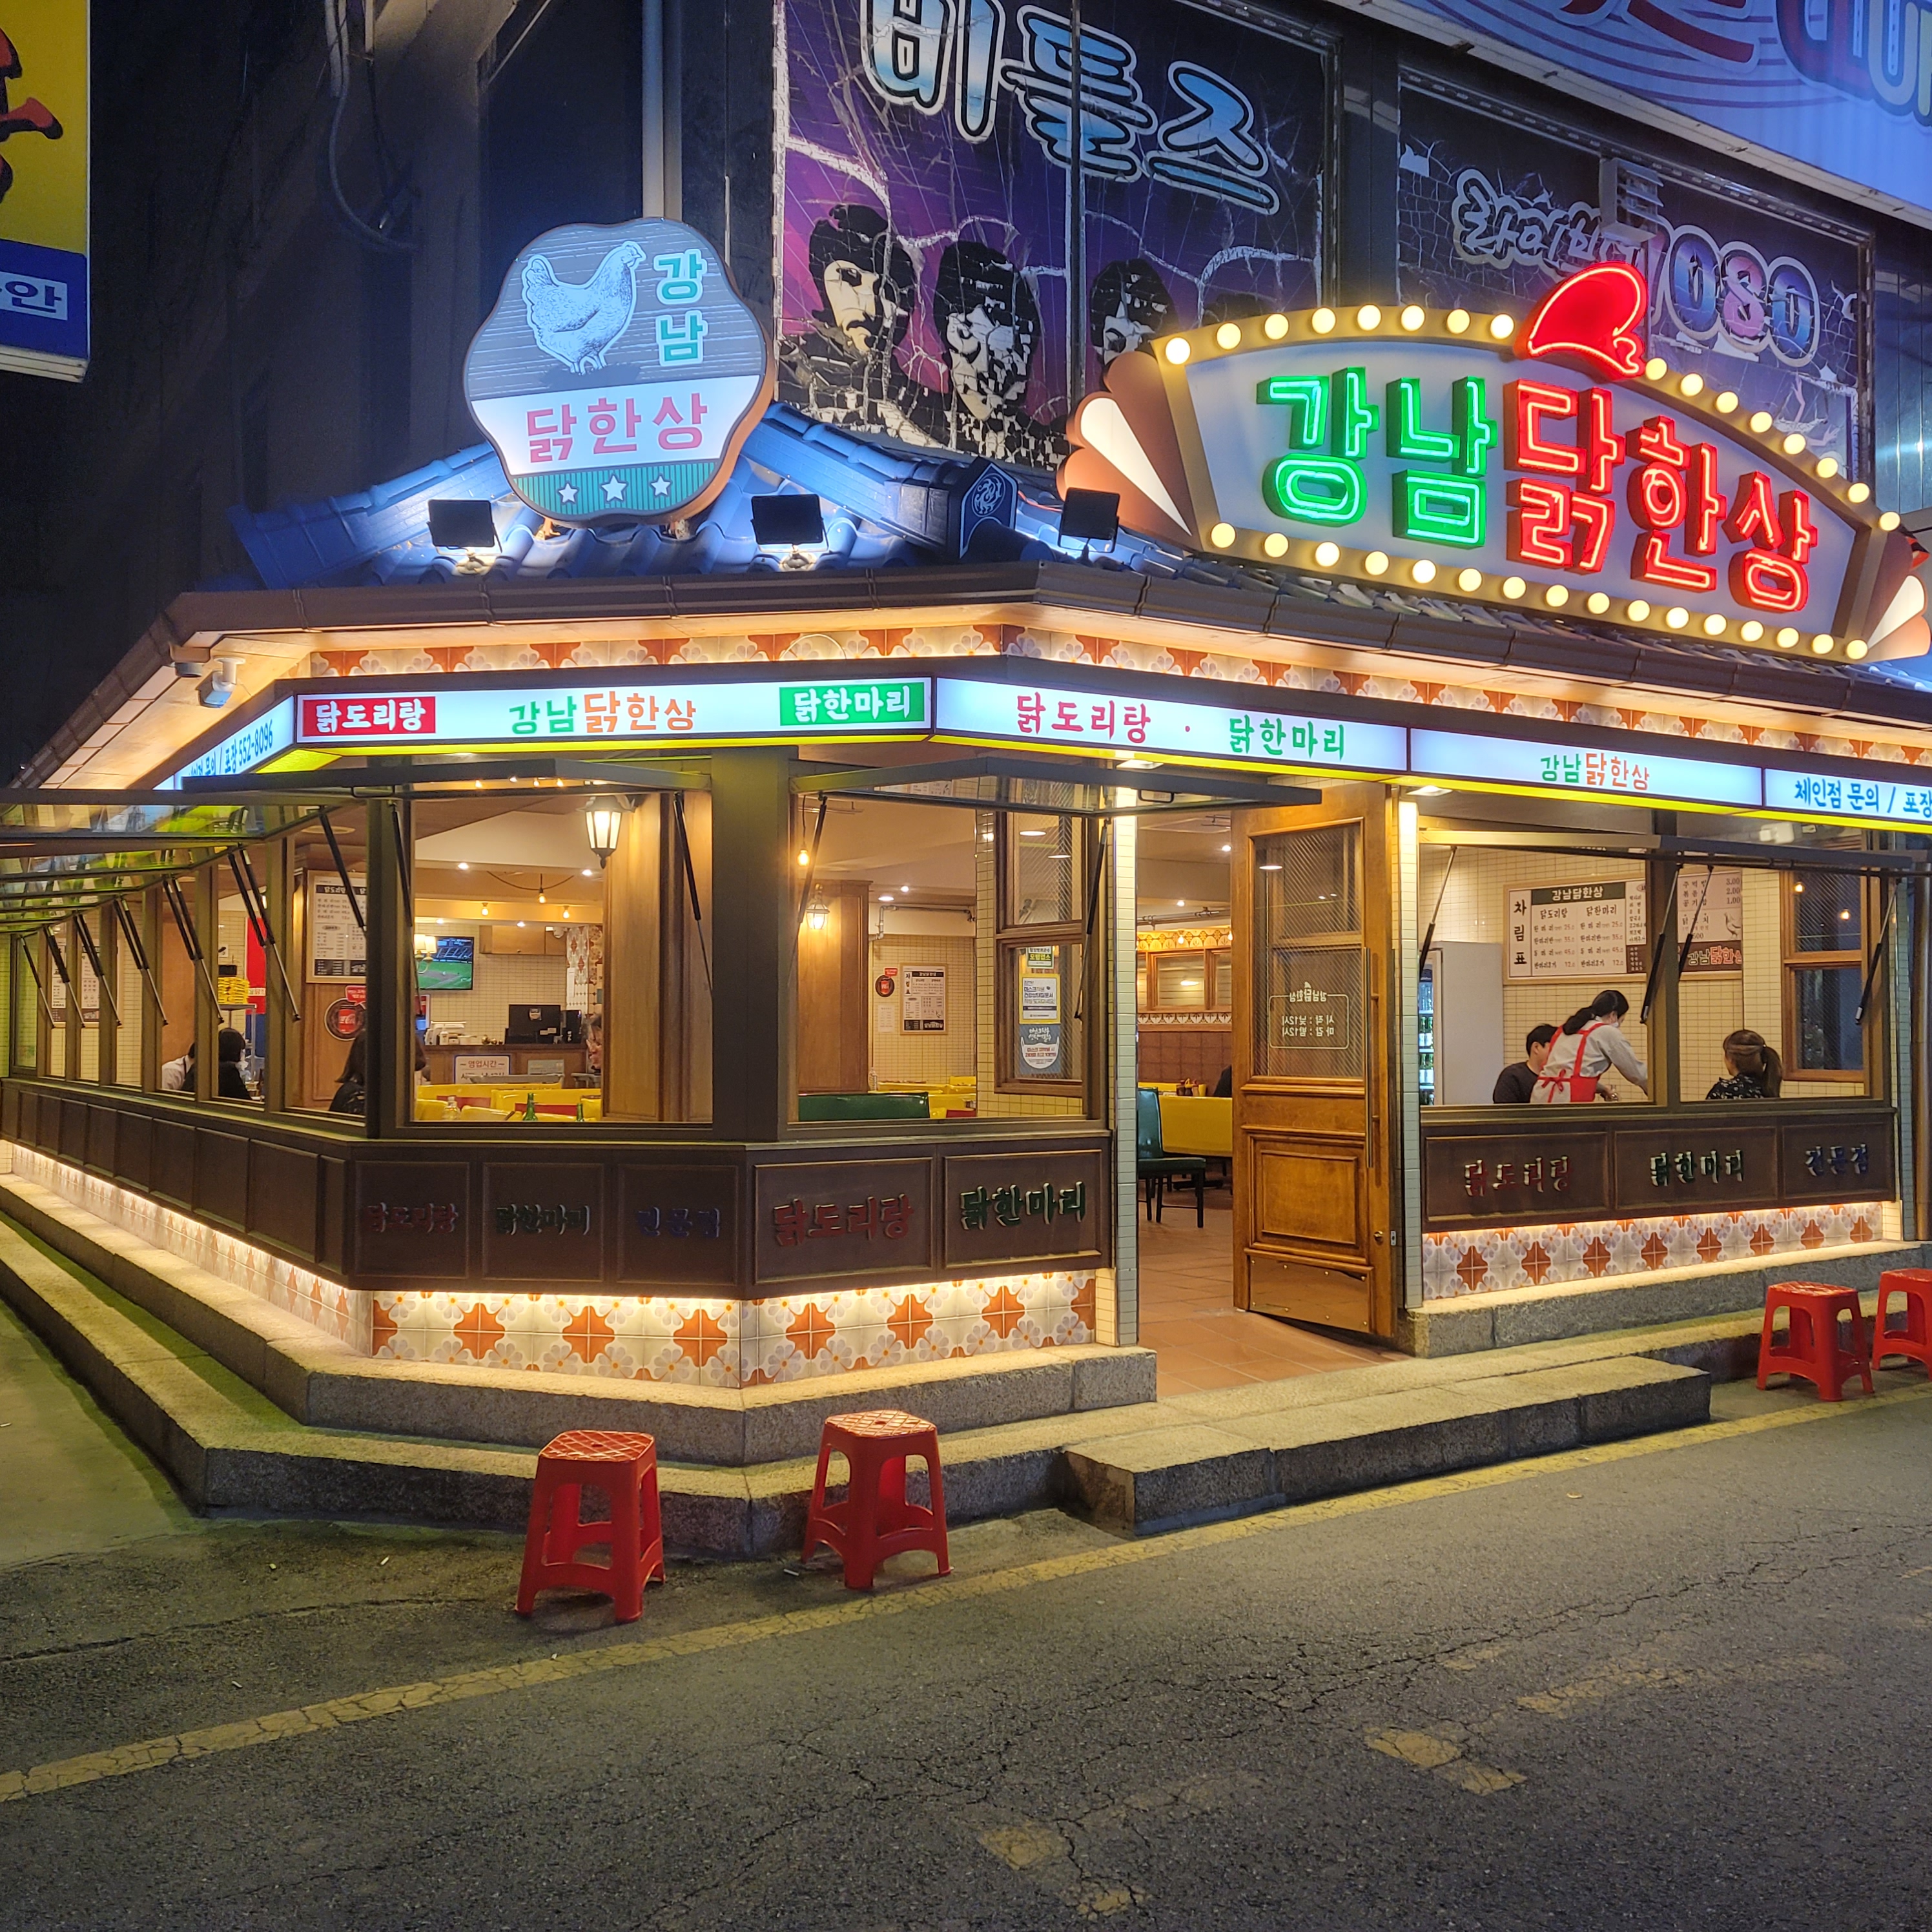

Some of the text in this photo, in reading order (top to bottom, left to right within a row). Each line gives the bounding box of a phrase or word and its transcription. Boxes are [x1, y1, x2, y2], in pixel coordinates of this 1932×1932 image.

[861, 0, 1280, 215] 비틀즈
[655, 252, 706, 364] 강남
[526, 392, 708, 463] 닭한상
[314, 697, 426, 734] 닭도리탕
[793, 685, 910, 723] 닭한마리
[1016, 691, 1151, 744] 닭도리탕
[1229, 714, 1346, 761] 닭한마리
[238, 718, 273, 767] 552-8096
[1794, 777, 1842, 809] 체인점
[1847, 783, 1879, 812] 문의
[1903, 789, 1932, 818] 포장
[1514, 899, 1528, 965] 차림표
[1540, 907, 1568, 920] 닭도리탕
[1586, 903, 1617, 917] 닭한마리
[468, 1060, 497, 1068] 영업시간
[1464, 1155, 1572, 1197] 닭도리탕
[1650, 1149, 1744, 1187] 닭한마리
[773, 1193, 915, 1246] 닭도리탕
[960, 1180, 1086, 1231] 닭한마리
